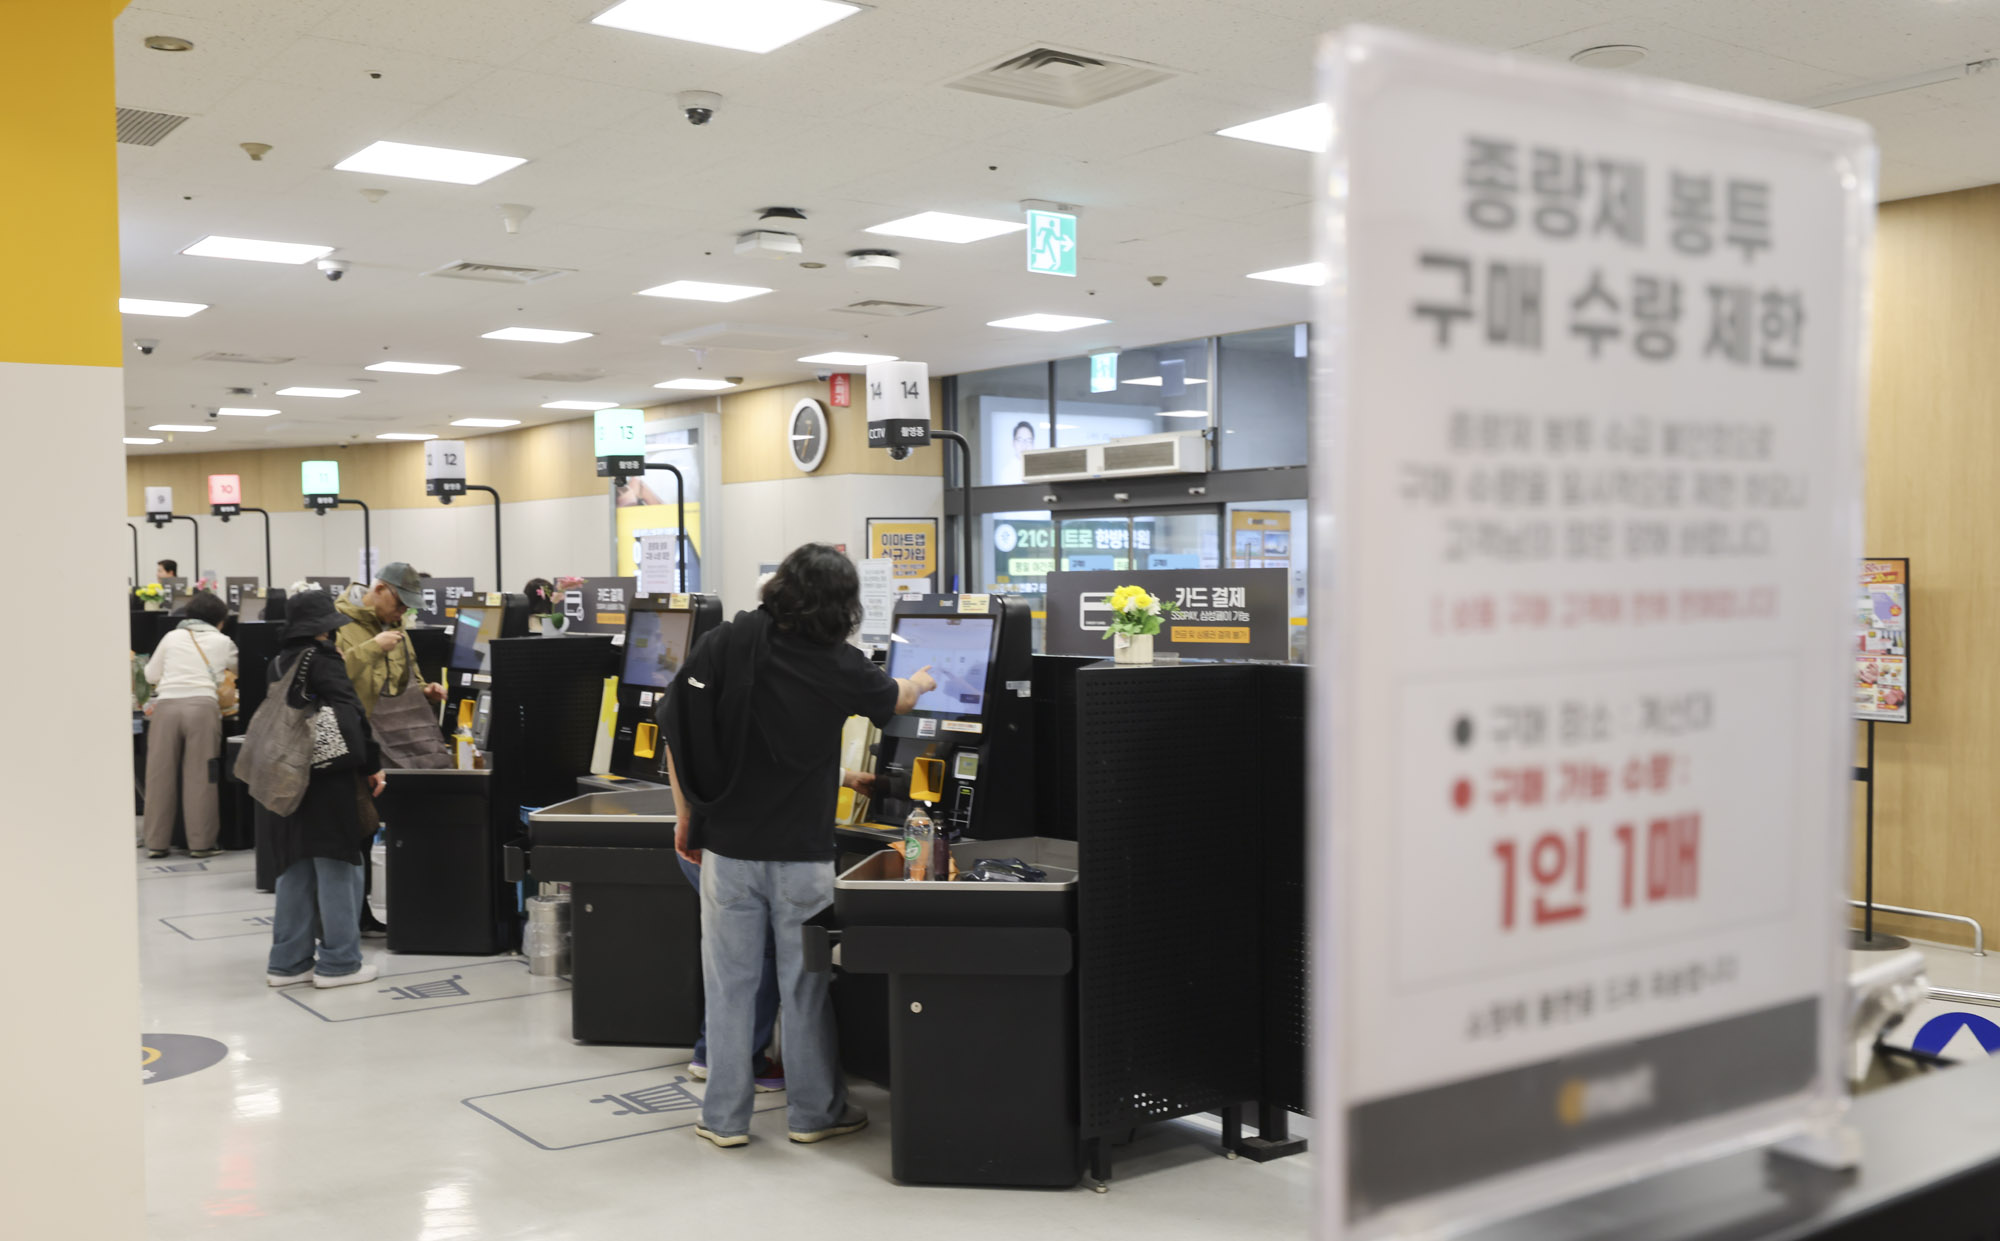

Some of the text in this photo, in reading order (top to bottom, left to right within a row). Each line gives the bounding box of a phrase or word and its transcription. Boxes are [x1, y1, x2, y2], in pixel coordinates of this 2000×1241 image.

[1461, 134, 1773, 265] 종량제 봉투
[1413, 249, 1804, 371] 구매 수량 제한
[870, 381, 882, 400] 14
[901, 381, 919, 399] 14
[619, 425, 634, 440] 13
[443, 453, 458, 466] 12
[221, 484, 233, 494] 10
[881, 534, 926, 547] 이마트앱
[1175, 587, 1246, 608] 카드 결제
[1233, 610, 1250, 622] 가능
[1488, 764, 1545, 810] 구매
[1557, 760, 1610, 802] 가능
[1623, 752, 1673, 794] 수량
[1493, 809, 1703, 933] 1인 1매
